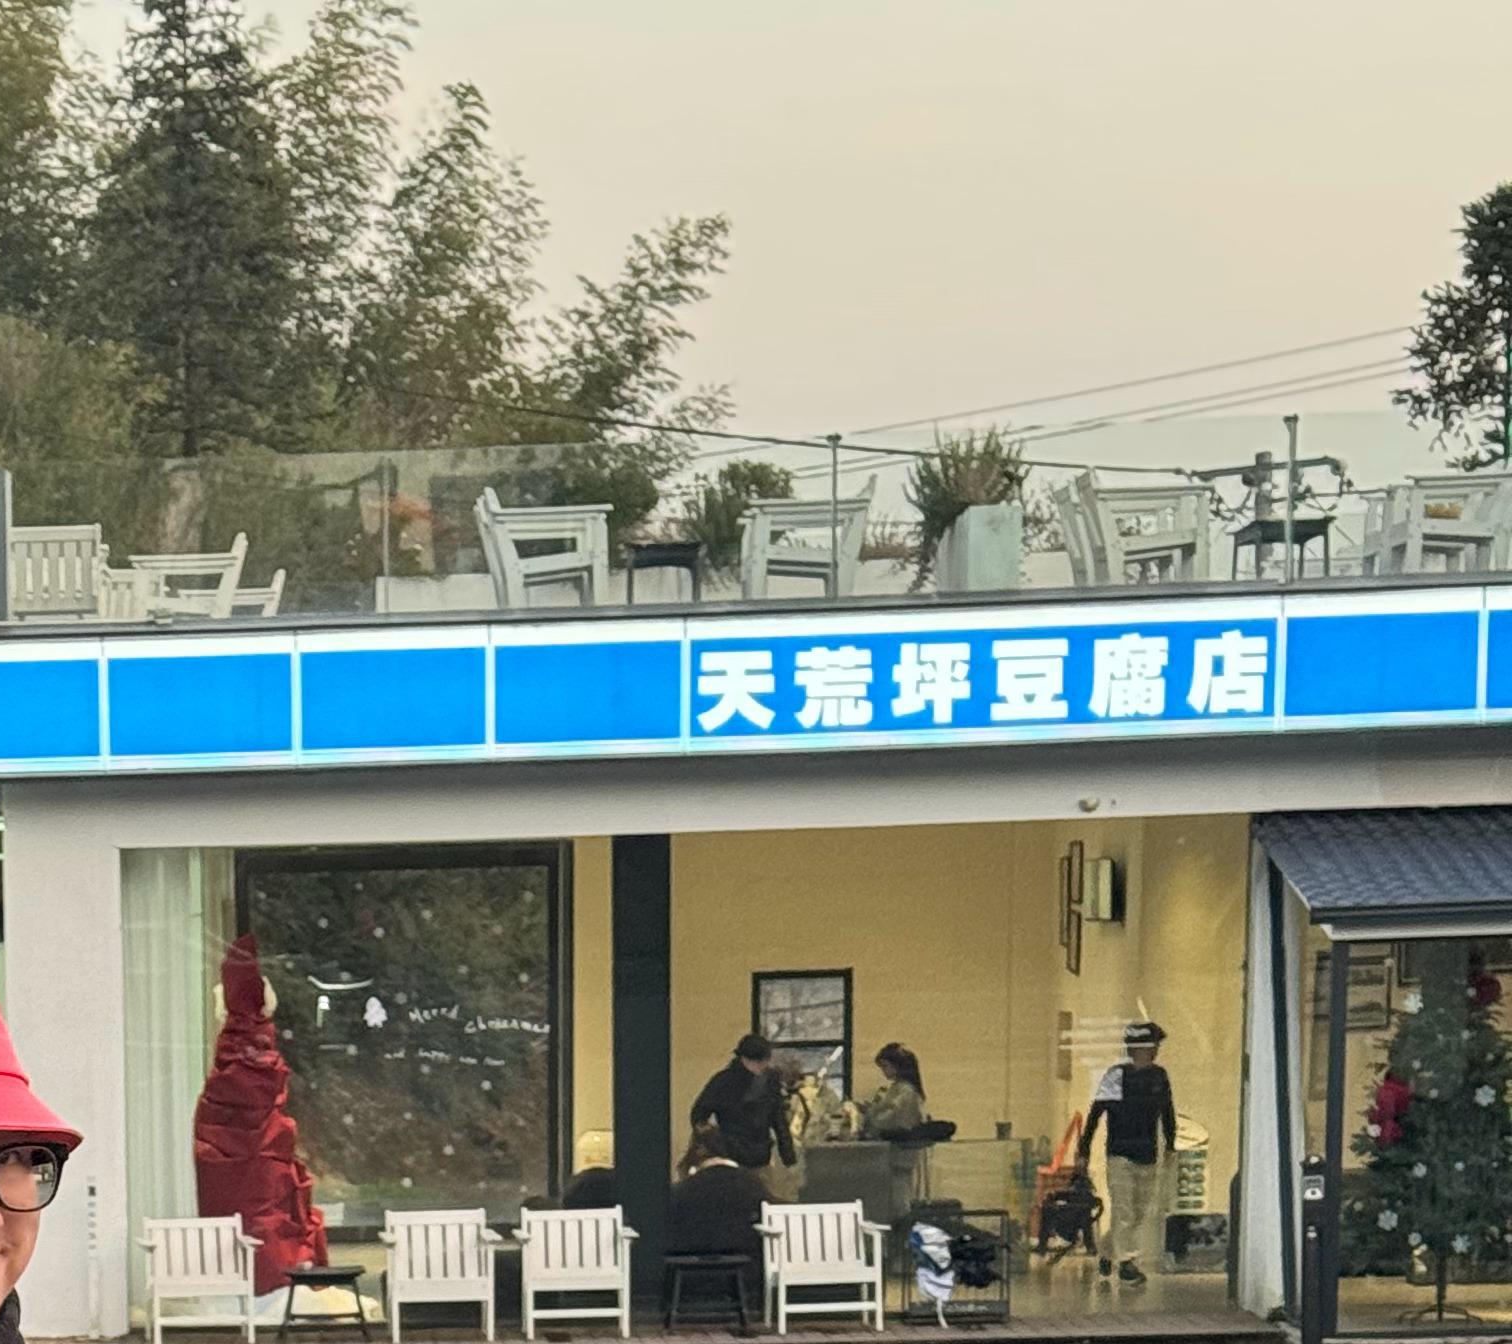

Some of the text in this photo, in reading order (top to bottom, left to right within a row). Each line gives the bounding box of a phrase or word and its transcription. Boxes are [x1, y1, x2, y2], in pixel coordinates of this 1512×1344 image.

[695, 629, 1271, 734] 天荒坪豆腐店
